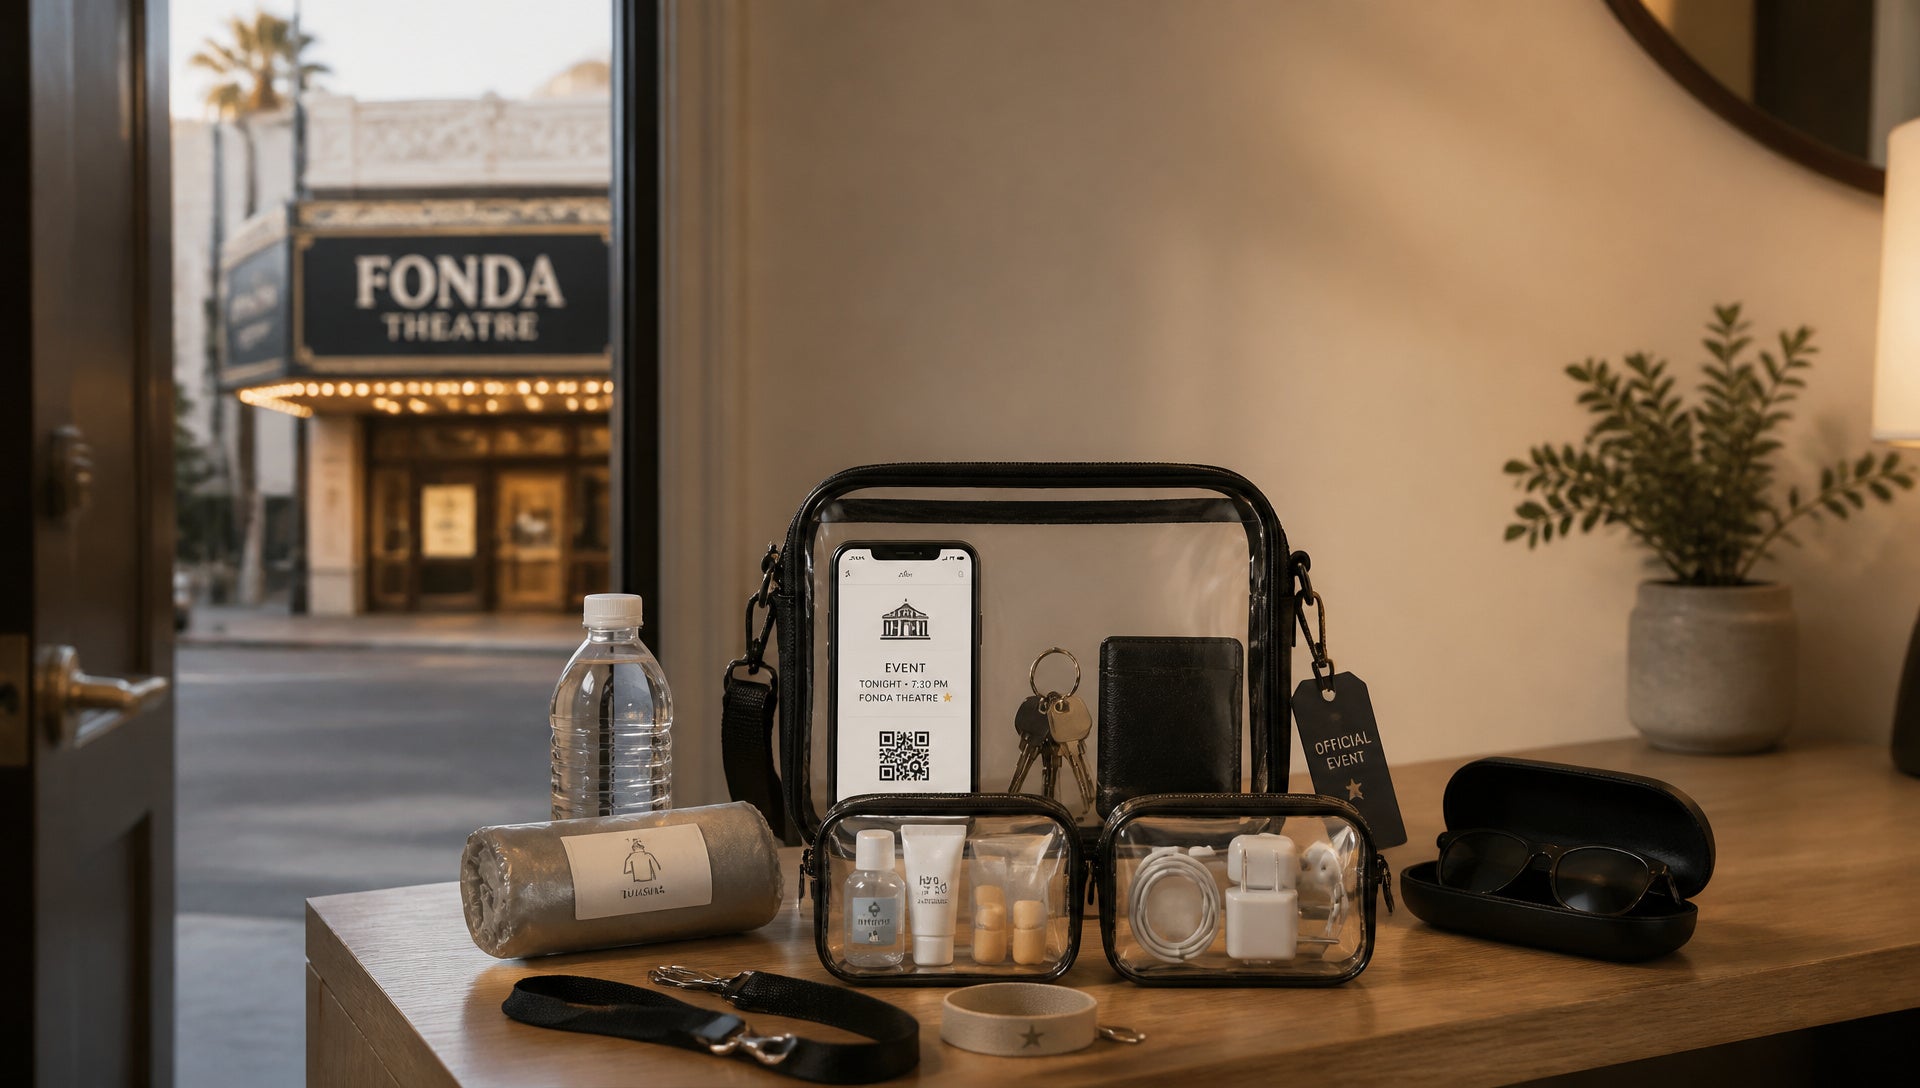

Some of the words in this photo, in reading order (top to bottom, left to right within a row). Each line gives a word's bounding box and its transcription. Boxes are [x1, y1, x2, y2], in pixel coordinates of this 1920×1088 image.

[355, 254, 565, 308] FONDA
[382, 312, 538, 341] THEATRE
[885, 662, 926, 673] EVENT
[859, 680, 902, 689] TONIGHT
[911, 680, 932, 689] 7:30
[934, 680, 948, 688] PM
[859, 693, 893, 702] FONDA
[895, 693, 938, 702] THEATRE
[1315, 731, 1372, 755] OFFICIAL
[1326, 751, 1365, 770] EVENT
